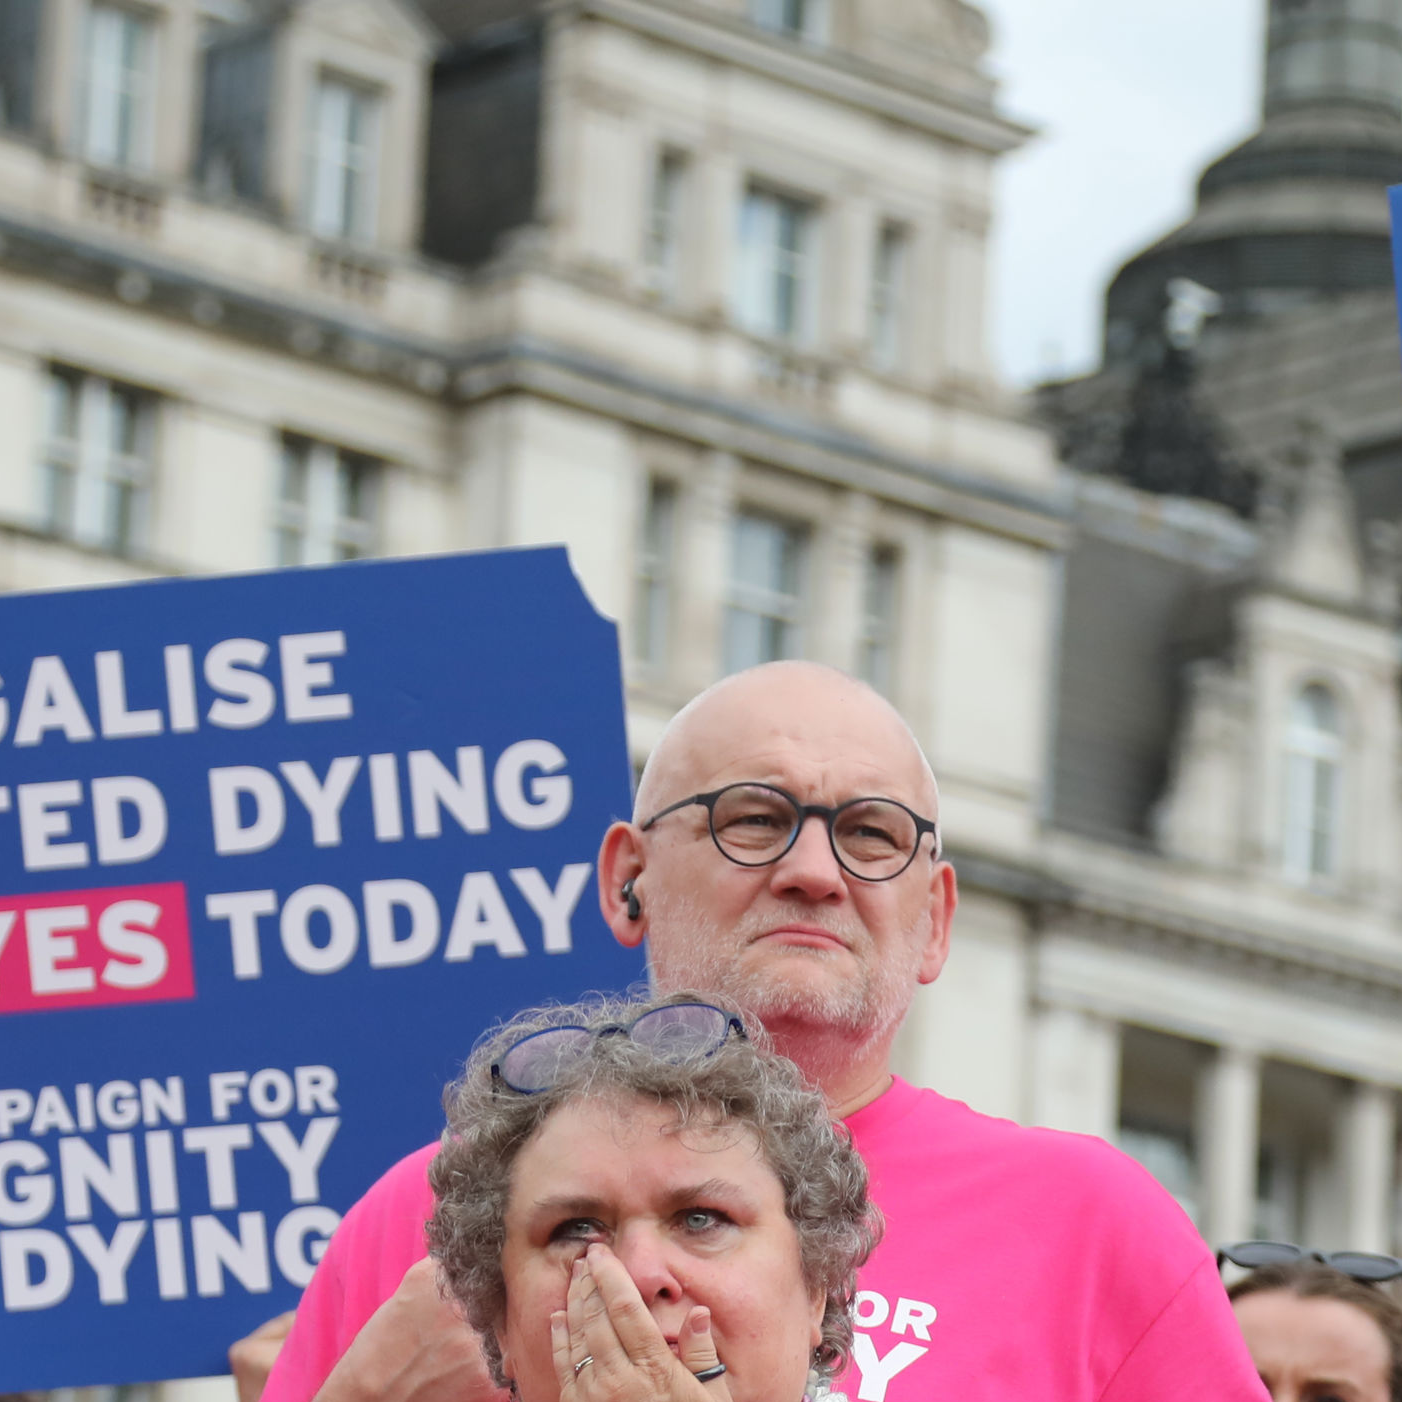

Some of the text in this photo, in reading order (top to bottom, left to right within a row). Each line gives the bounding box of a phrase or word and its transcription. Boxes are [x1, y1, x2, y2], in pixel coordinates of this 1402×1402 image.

[208, 739, 572, 855] DYING
[205, 862, 593, 979] TODAY
[209, 1065, 339, 1121] FOR
[0, 1206, 343, 1312] DYING
[848, 1289, 939, 1343] OR
